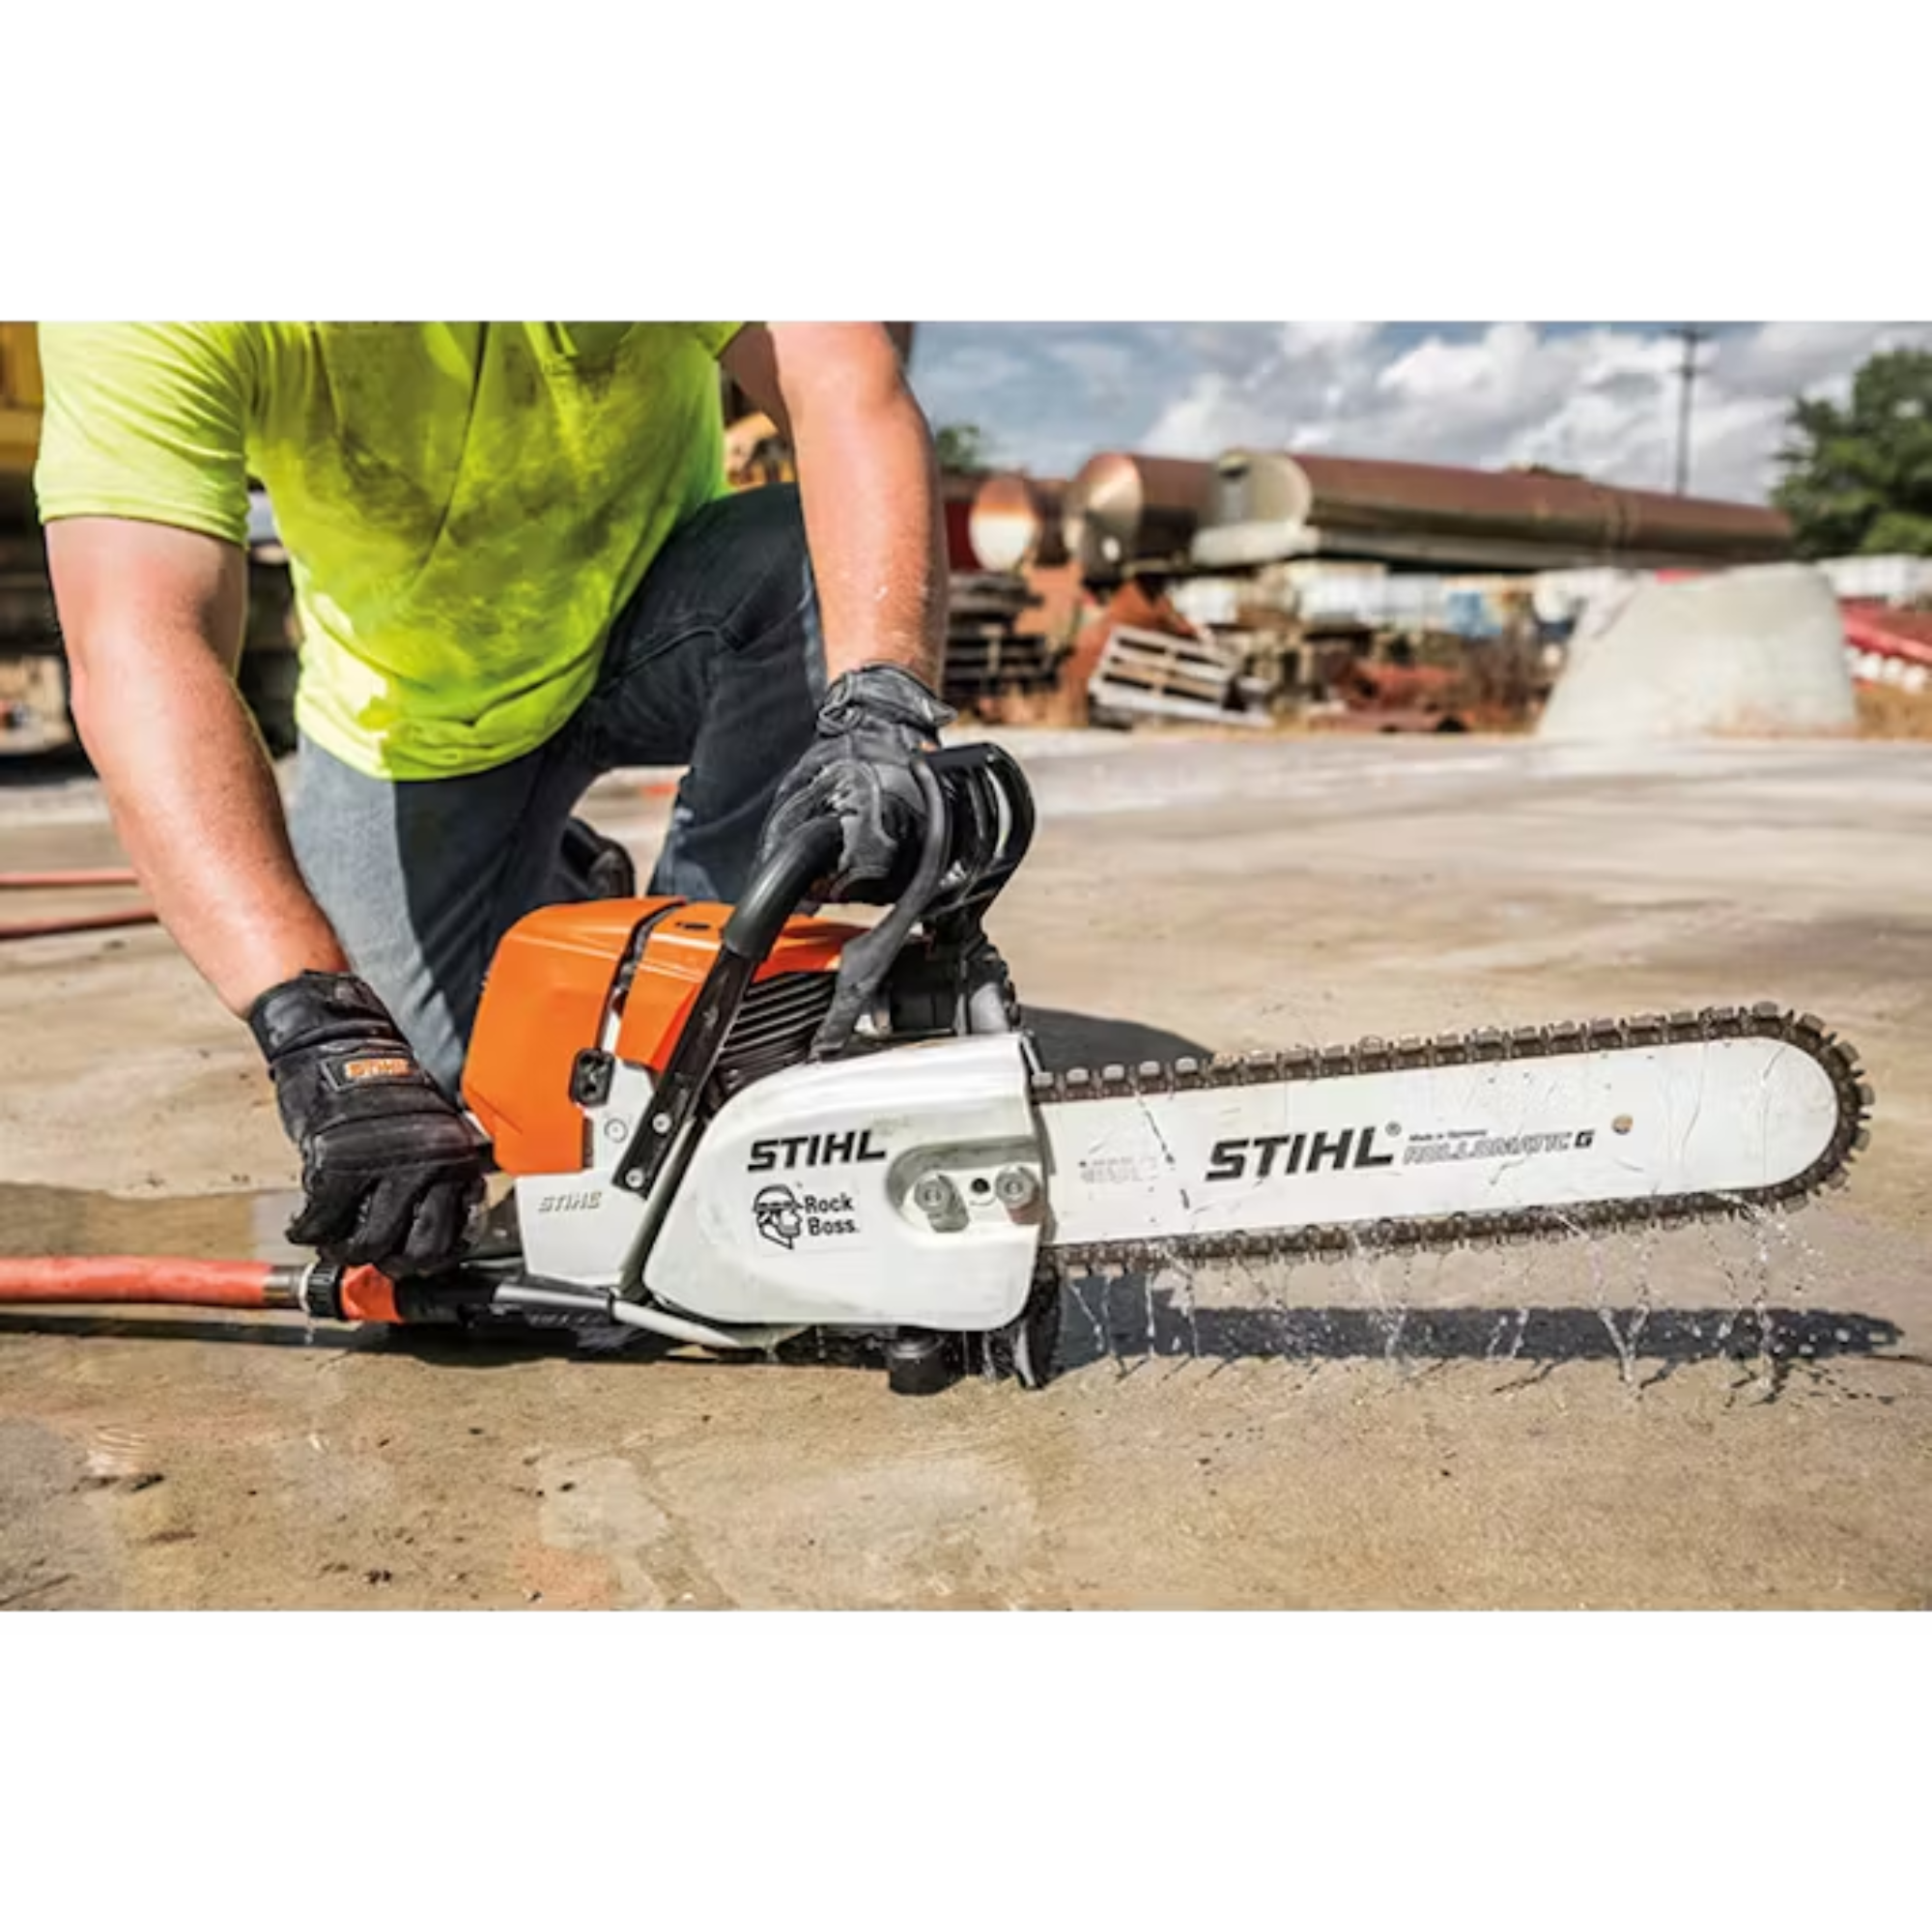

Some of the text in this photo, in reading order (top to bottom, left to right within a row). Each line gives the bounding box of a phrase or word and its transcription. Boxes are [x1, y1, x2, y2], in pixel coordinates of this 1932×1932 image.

[1575, 1129, 1596, 1148] G
[748, 1128, 887, 1172] STIHL
[804, 1192, 854, 1213] Rock
